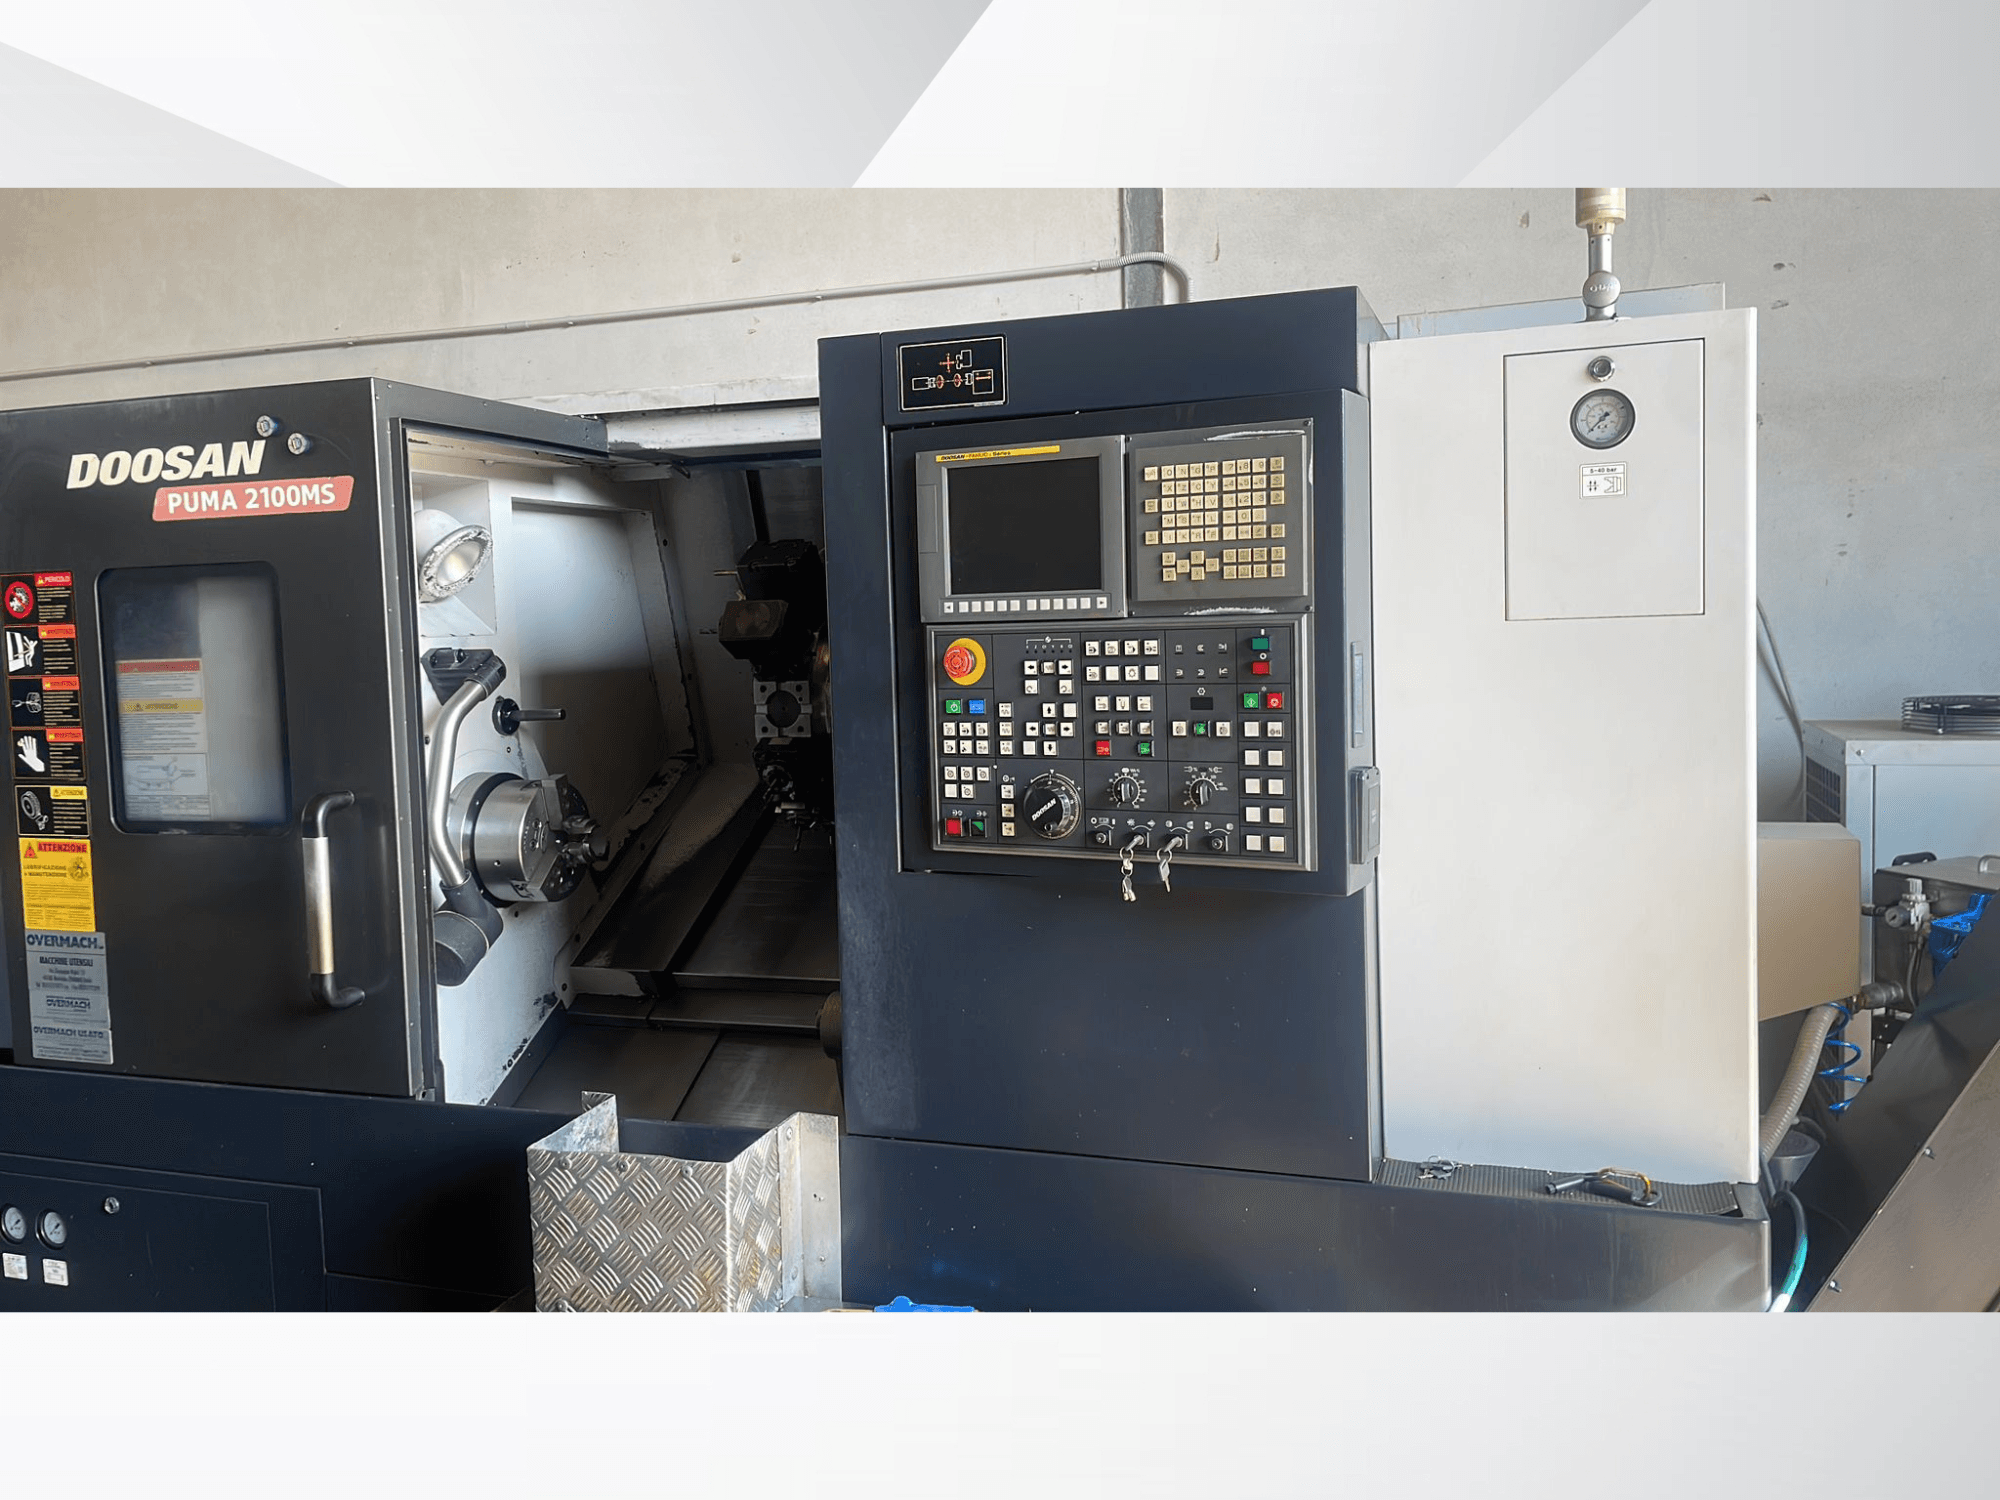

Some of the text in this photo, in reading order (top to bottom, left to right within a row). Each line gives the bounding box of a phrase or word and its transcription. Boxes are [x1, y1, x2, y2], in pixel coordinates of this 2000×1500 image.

[66, 440, 266, 490] DOOSAN
[167, 483, 336, 514] PUMA 2100MS
[1031, 798, 1057, 821] DOOSAN
[38, 842, 87, 853] ATTENZIONE
[27, 934, 97, 949] OVERMACH
[46, 999, 91, 1009] OVERMACH
